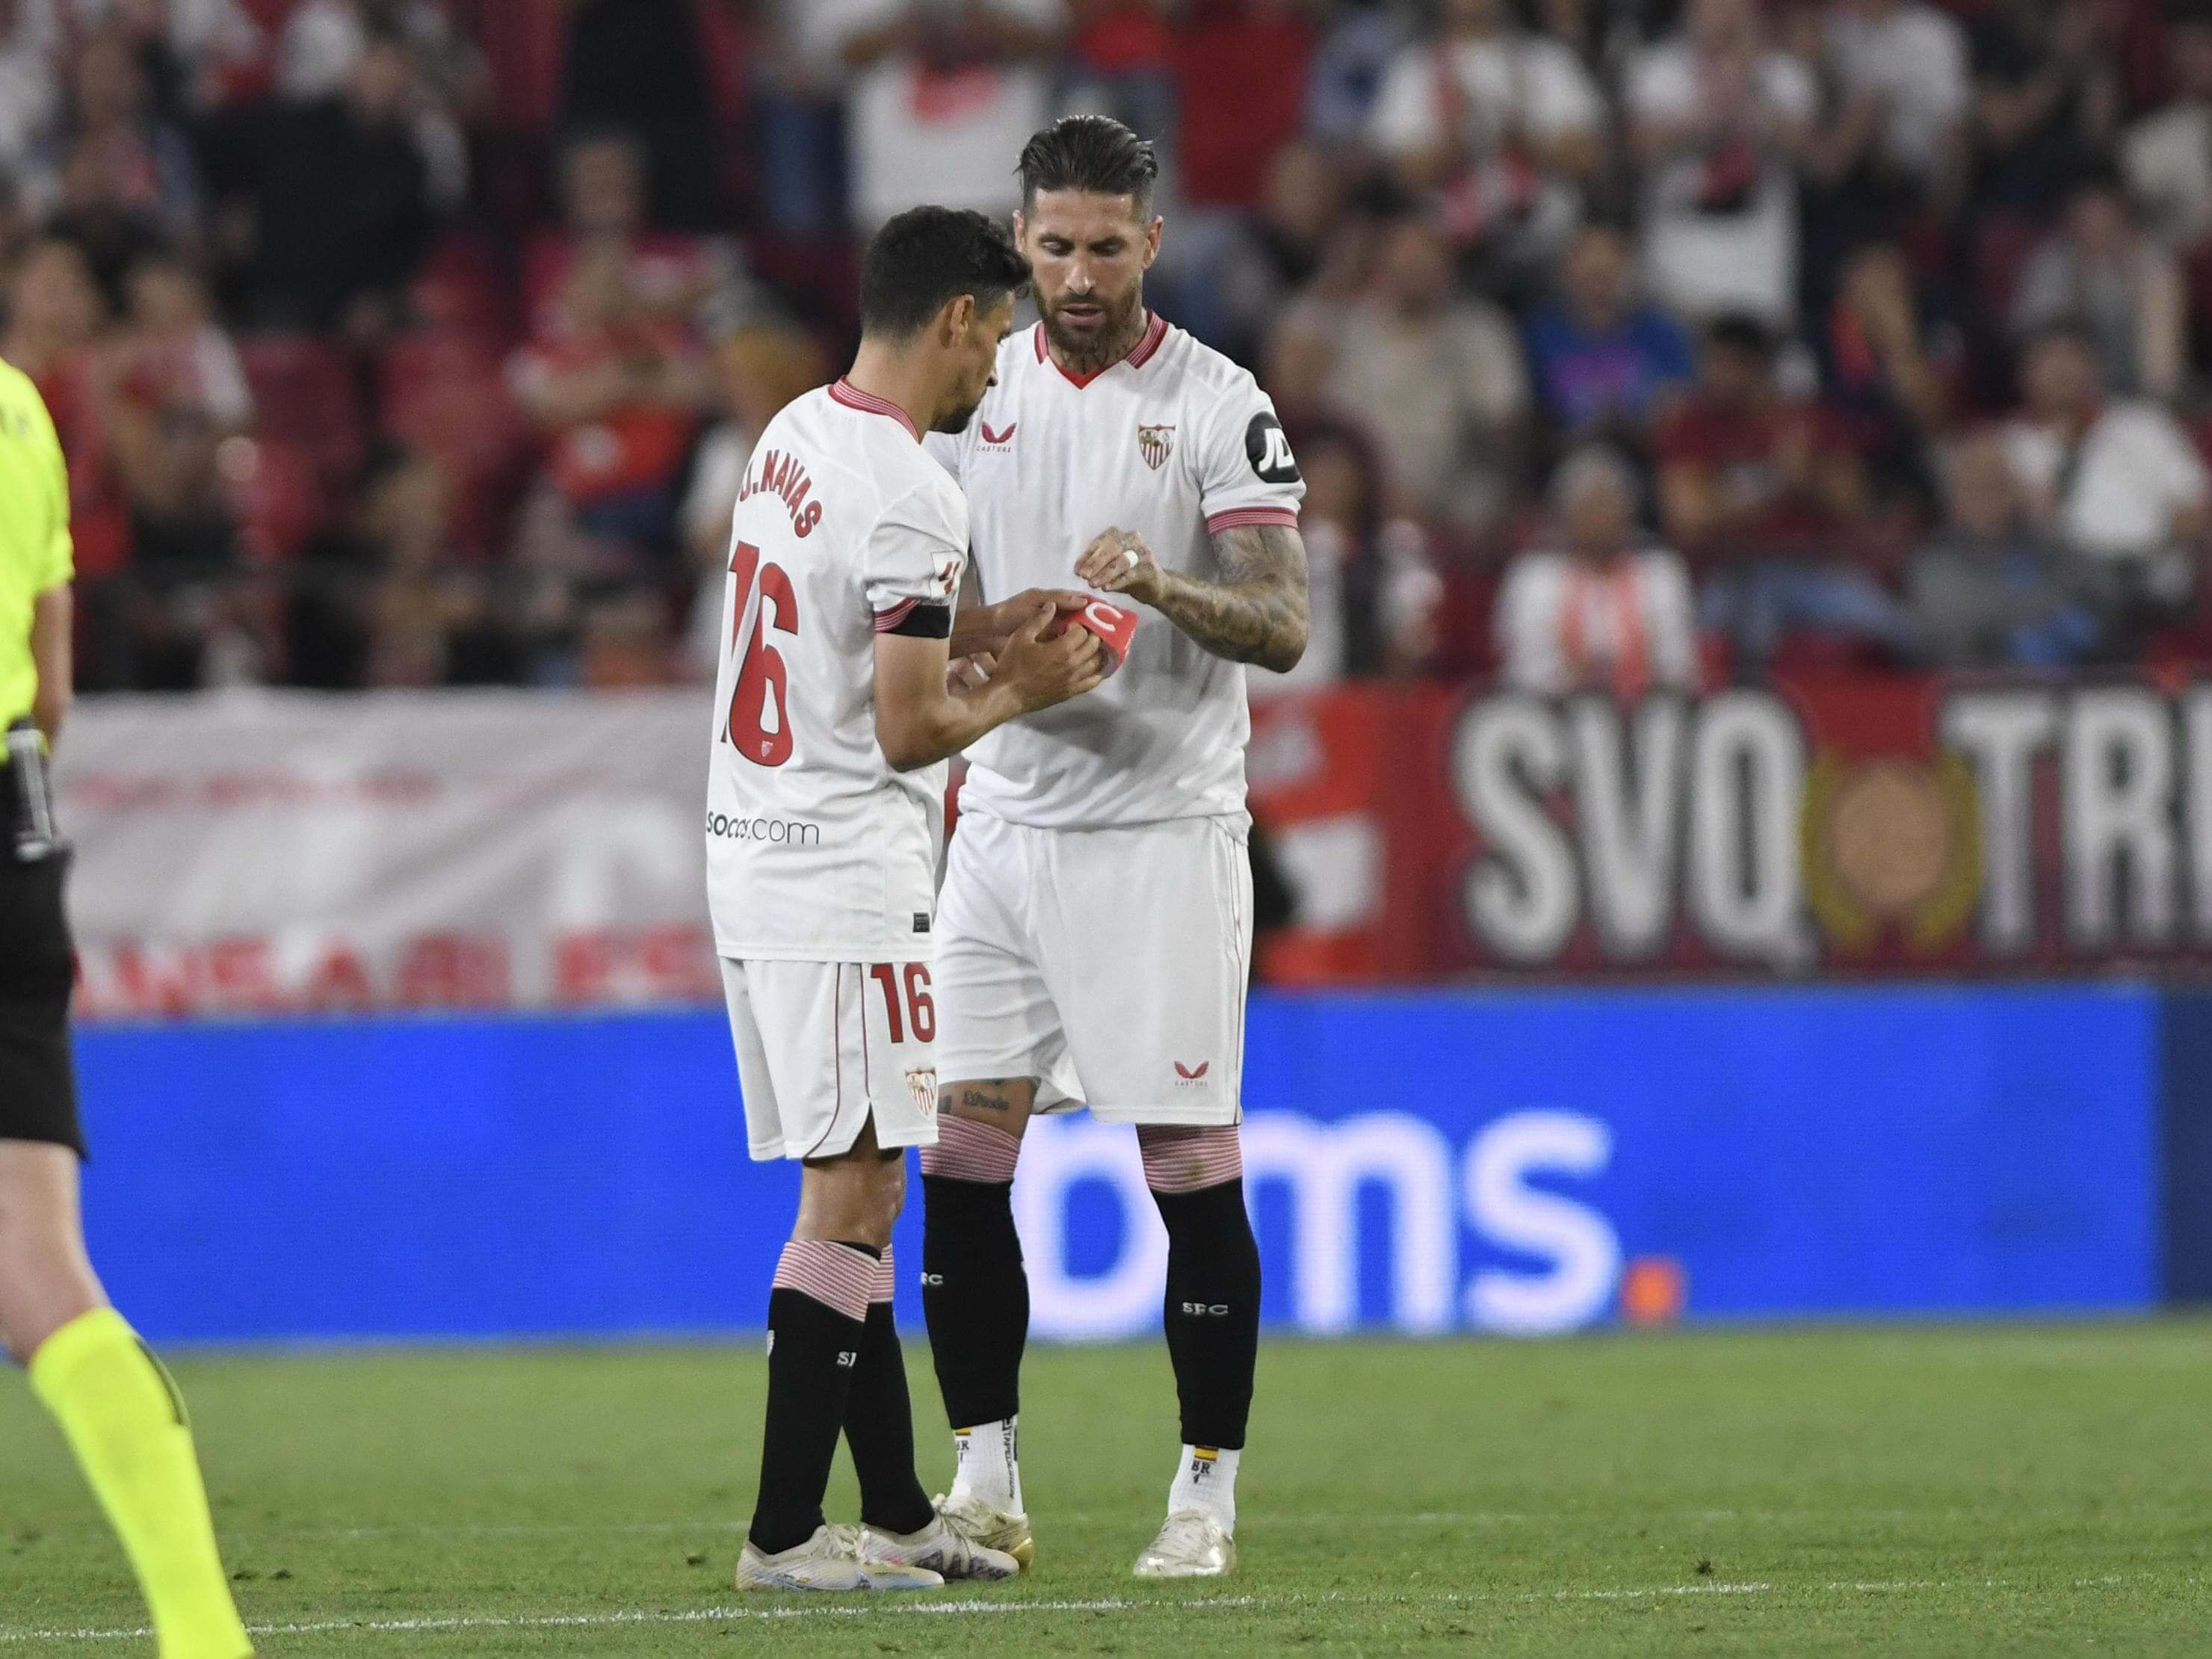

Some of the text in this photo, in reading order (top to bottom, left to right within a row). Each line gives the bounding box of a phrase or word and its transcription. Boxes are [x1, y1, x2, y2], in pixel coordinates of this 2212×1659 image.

[1259, 427, 1295, 472] JD
[740, 449, 822, 538] J.NAVAS
[720, 540, 799, 767] 16
[1085, 602, 1123, 632] C
[1454, 693, 1817, 971] SVQ
[871, 961, 936, 1043] 16
[1182, 1302, 1229, 1315] SFC
